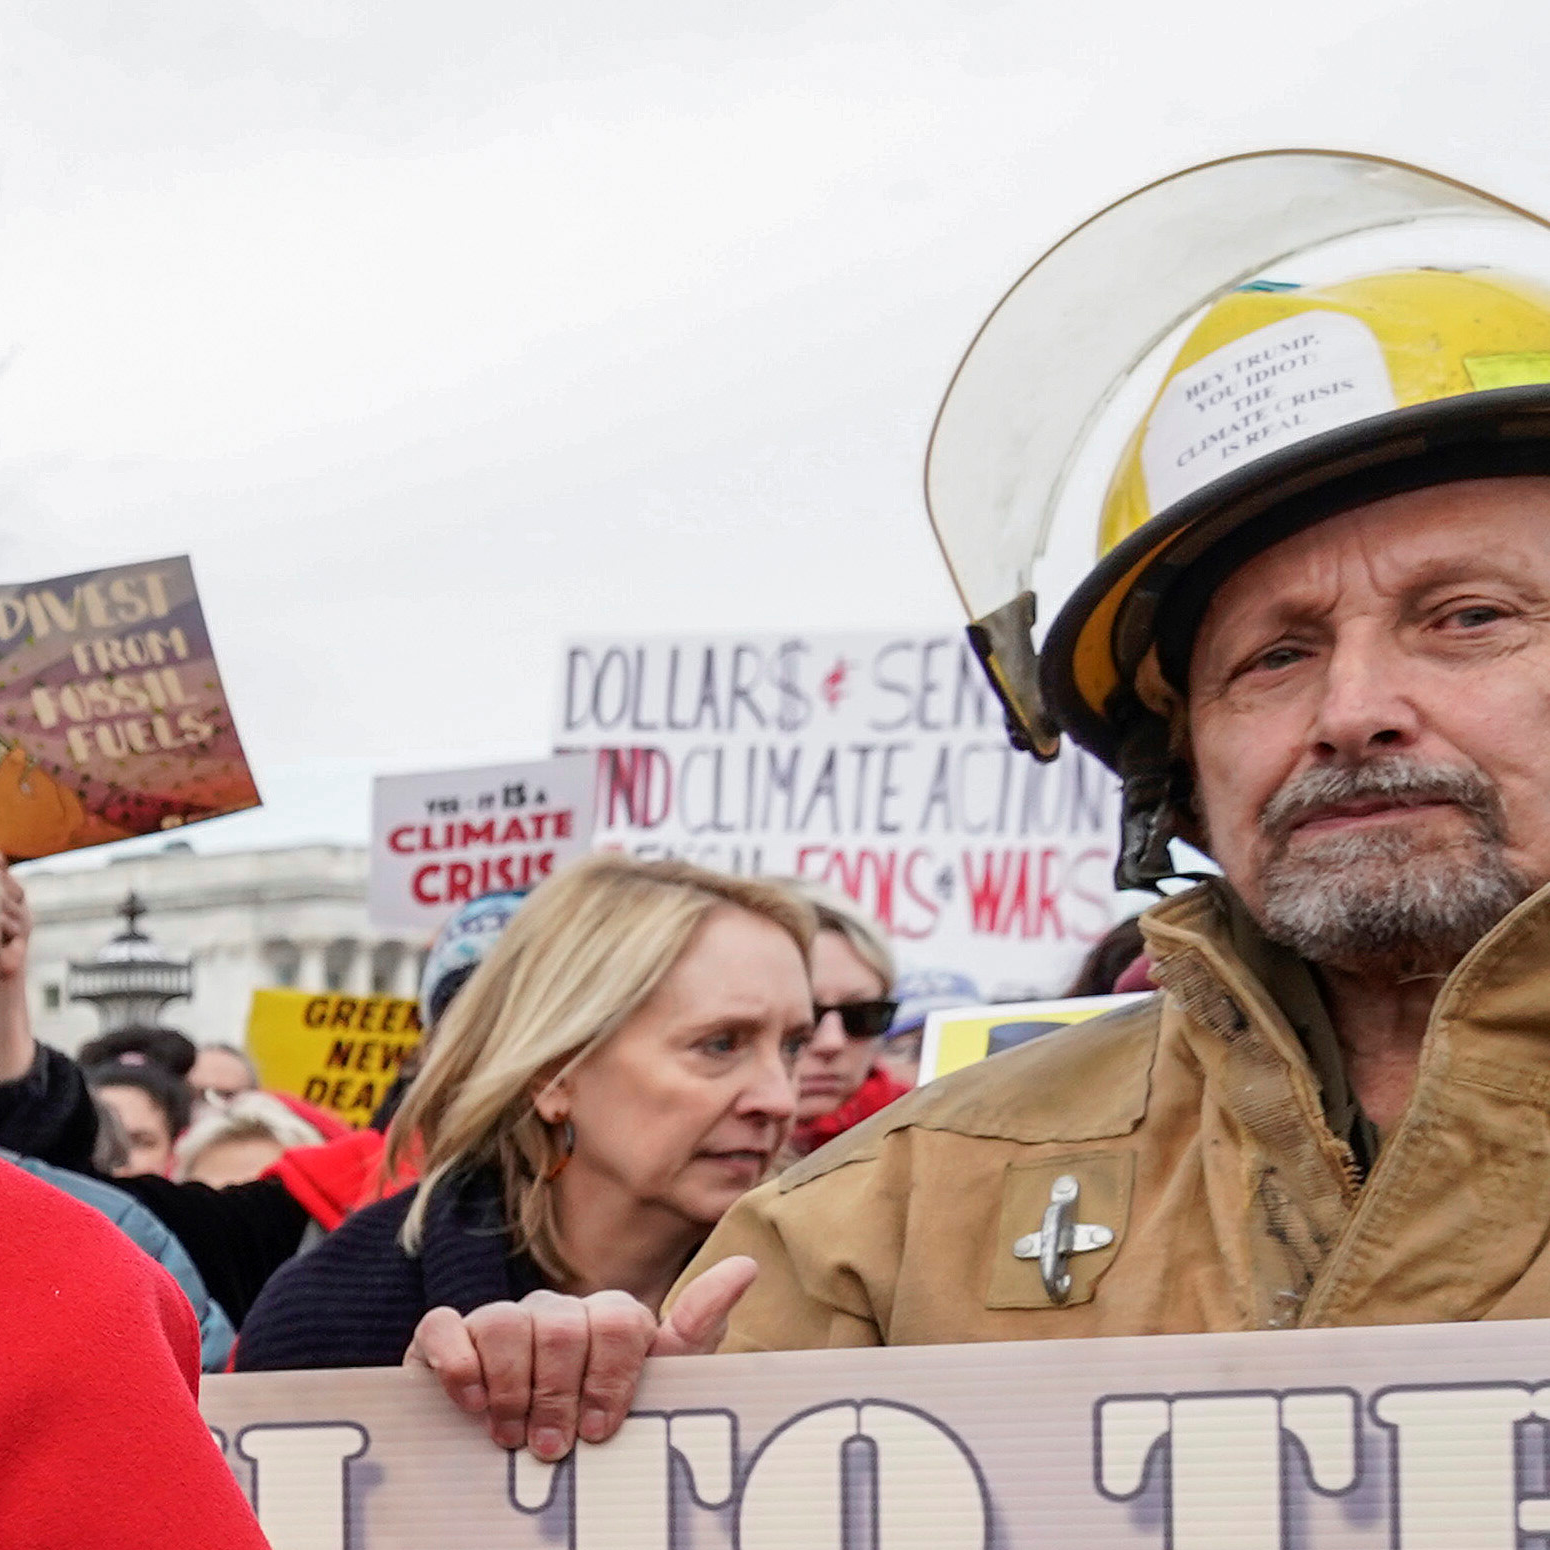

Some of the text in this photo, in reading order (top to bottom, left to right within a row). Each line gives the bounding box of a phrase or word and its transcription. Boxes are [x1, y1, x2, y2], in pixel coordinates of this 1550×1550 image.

[1176, 378, 1355, 468] CLIMATE CRISIS
[1195, 384, 1239, 413] YOU
[1230, 384, 1276, 413] THE
[1245, 412, 1308, 447] REAL
[71, 626, 189, 676] FROM
[30, 666, 192, 730] FOSSIL
[867, 636, 992, 733] SEN
[66, 711, 215, 764] FUELS
[553, 744, 673, 831] ND
[677, 743, 912, 834] CLIMATE
[387, 808, 574, 856] CLIMATE
[961, 844, 1116, 941] WARS
[303, 1075, 377, 1110] DEA
